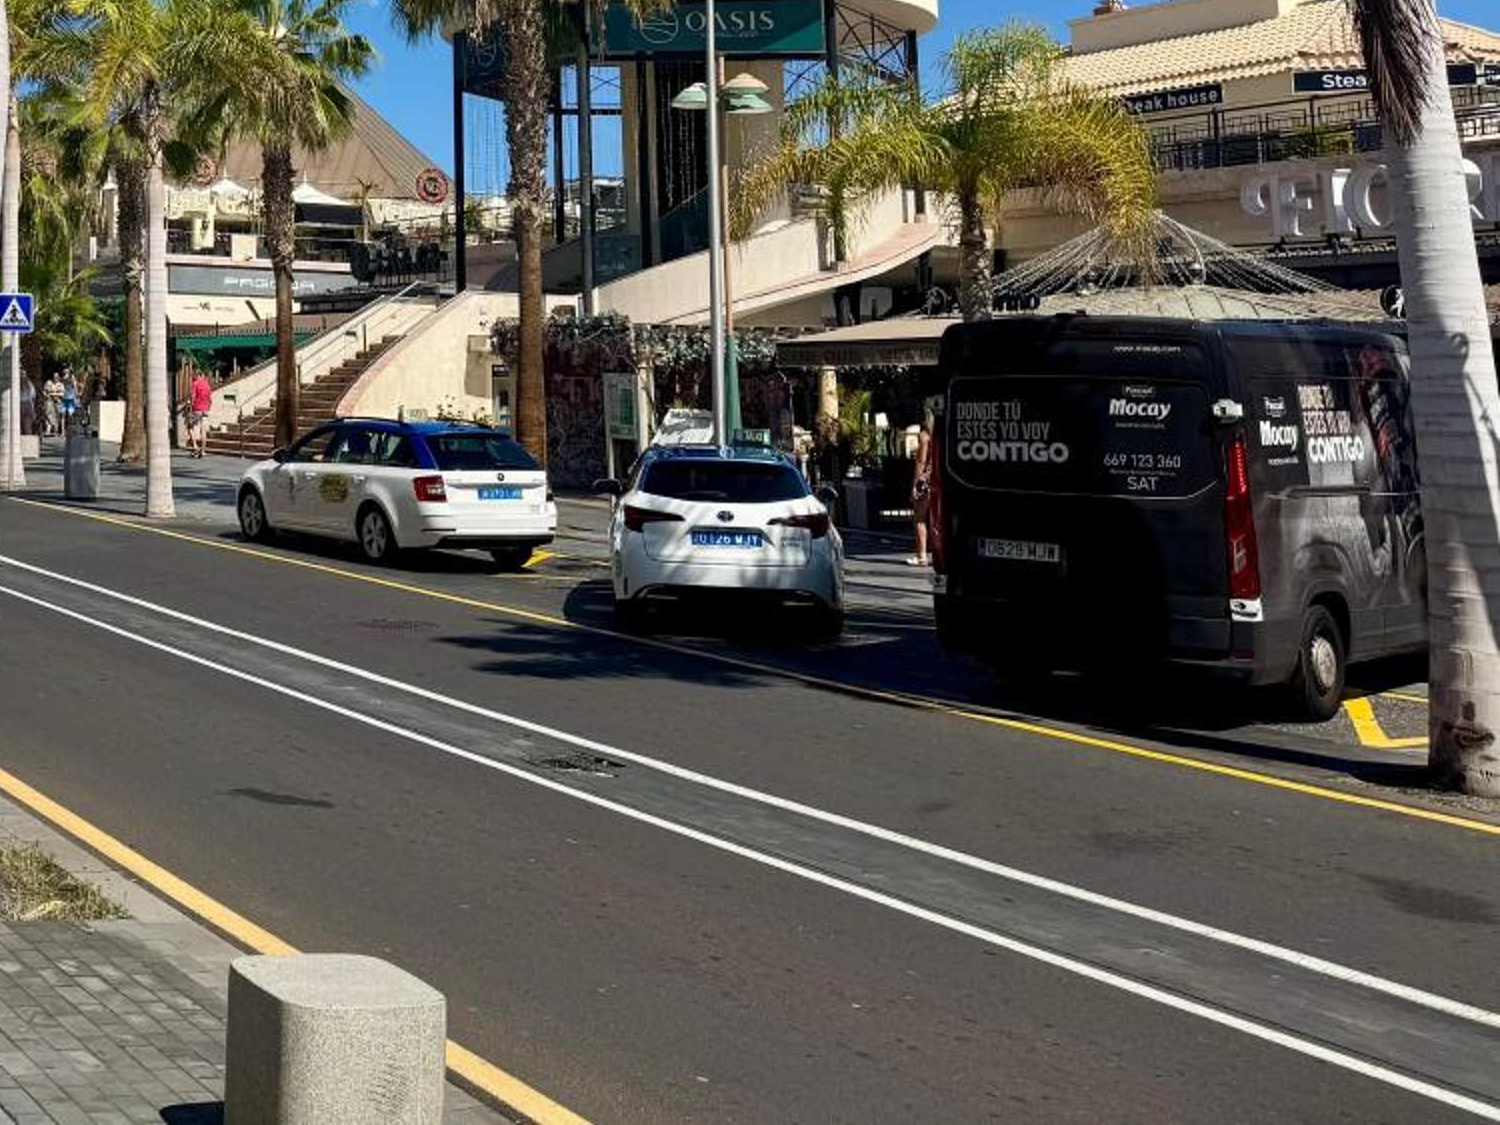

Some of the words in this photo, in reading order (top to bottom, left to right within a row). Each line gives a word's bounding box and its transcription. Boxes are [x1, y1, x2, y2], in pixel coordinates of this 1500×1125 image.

[685, 10, 775, 31] OASIS
[1321, 74, 1368, 89] Stea
[1167, 89, 1218, 107] house
[957, 402, 1000, 420] DONDE
[1109, 398, 1171, 420] Mocay
[1000, 421, 1019, 440] YO
[1022, 421, 1051, 441] VOY
[1259, 420, 1298, 452] Mocay
[957, 440, 1069, 463] CONTIGO
[1308, 436, 1365, 463] CONTIGO
[1103, 453, 1127, 466] 669
[1131, 454, 1154, 467] 123
[1157, 455, 1181, 468] 360
[1127, 476, 1158, 491] SAT
